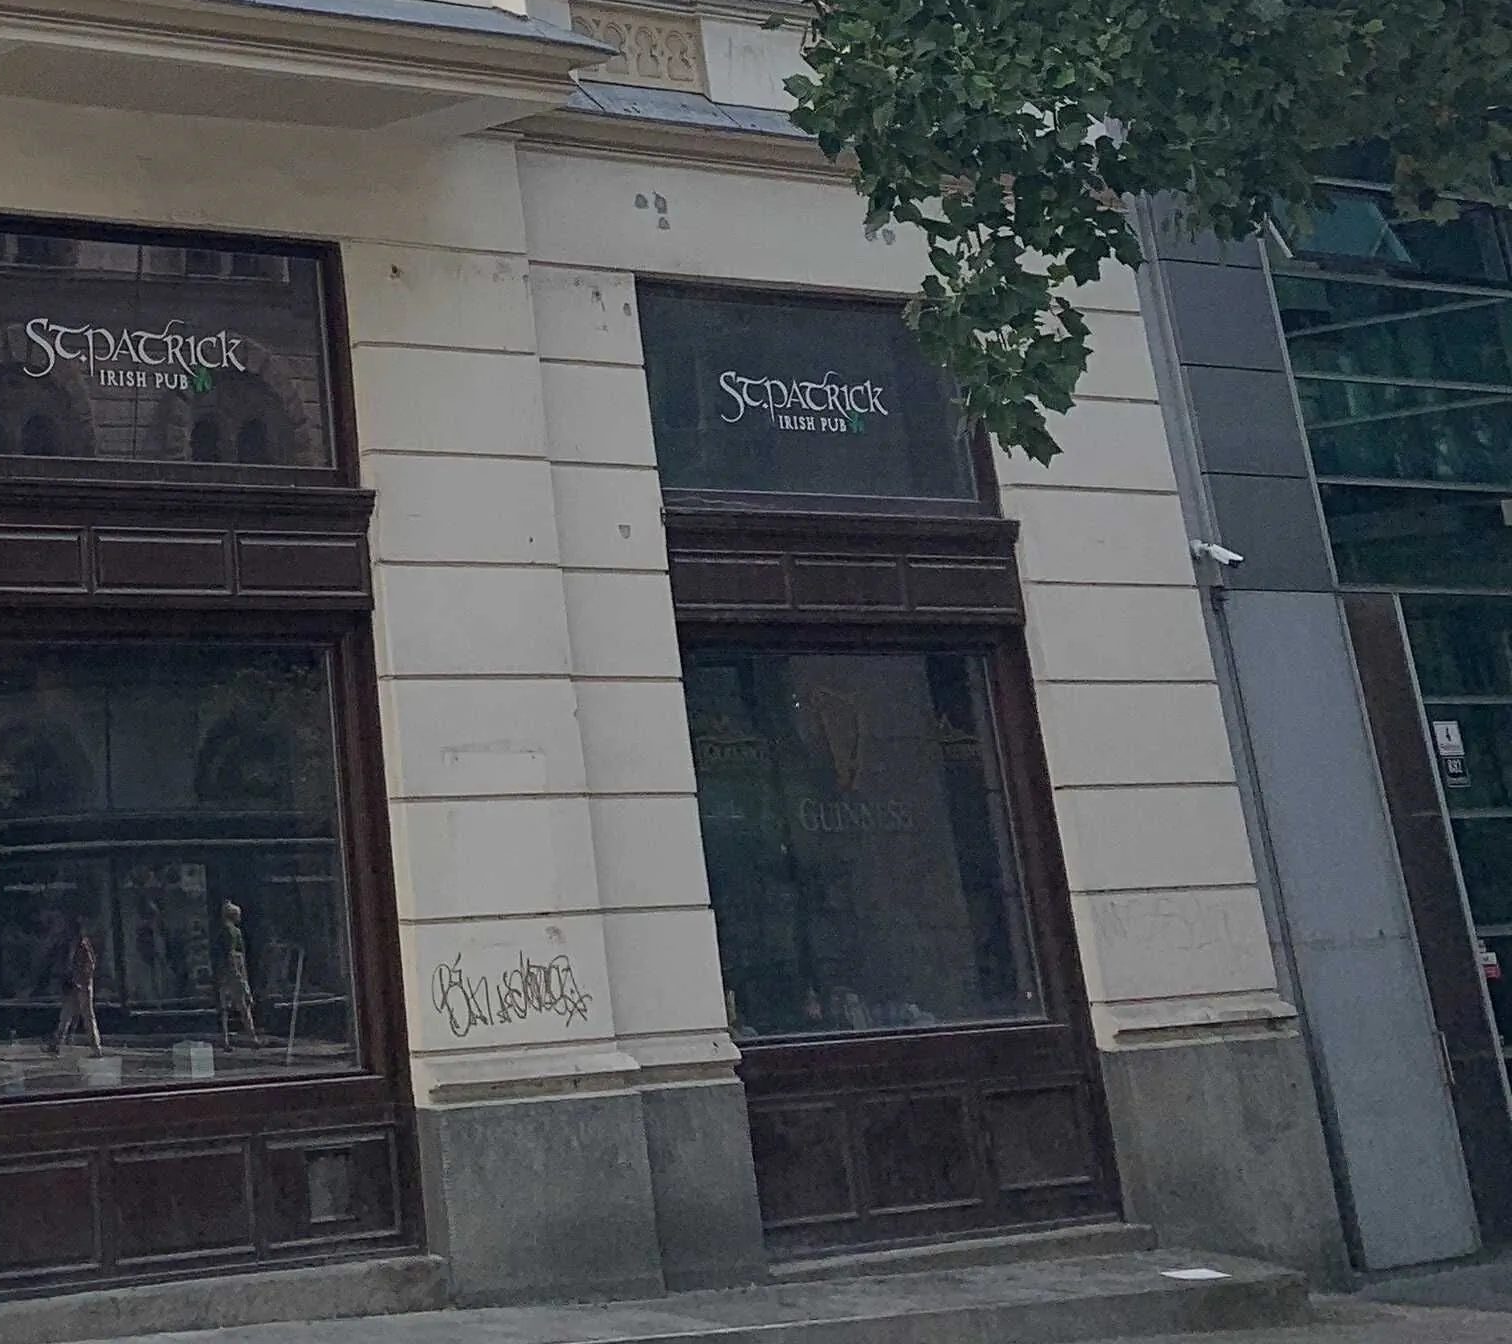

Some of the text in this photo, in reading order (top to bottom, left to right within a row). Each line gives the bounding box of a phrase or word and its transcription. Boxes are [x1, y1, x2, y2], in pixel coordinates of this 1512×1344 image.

[99, 369, 188, 390] IRISH PUB
[778, 415, 847, 433] IRISH PUB
